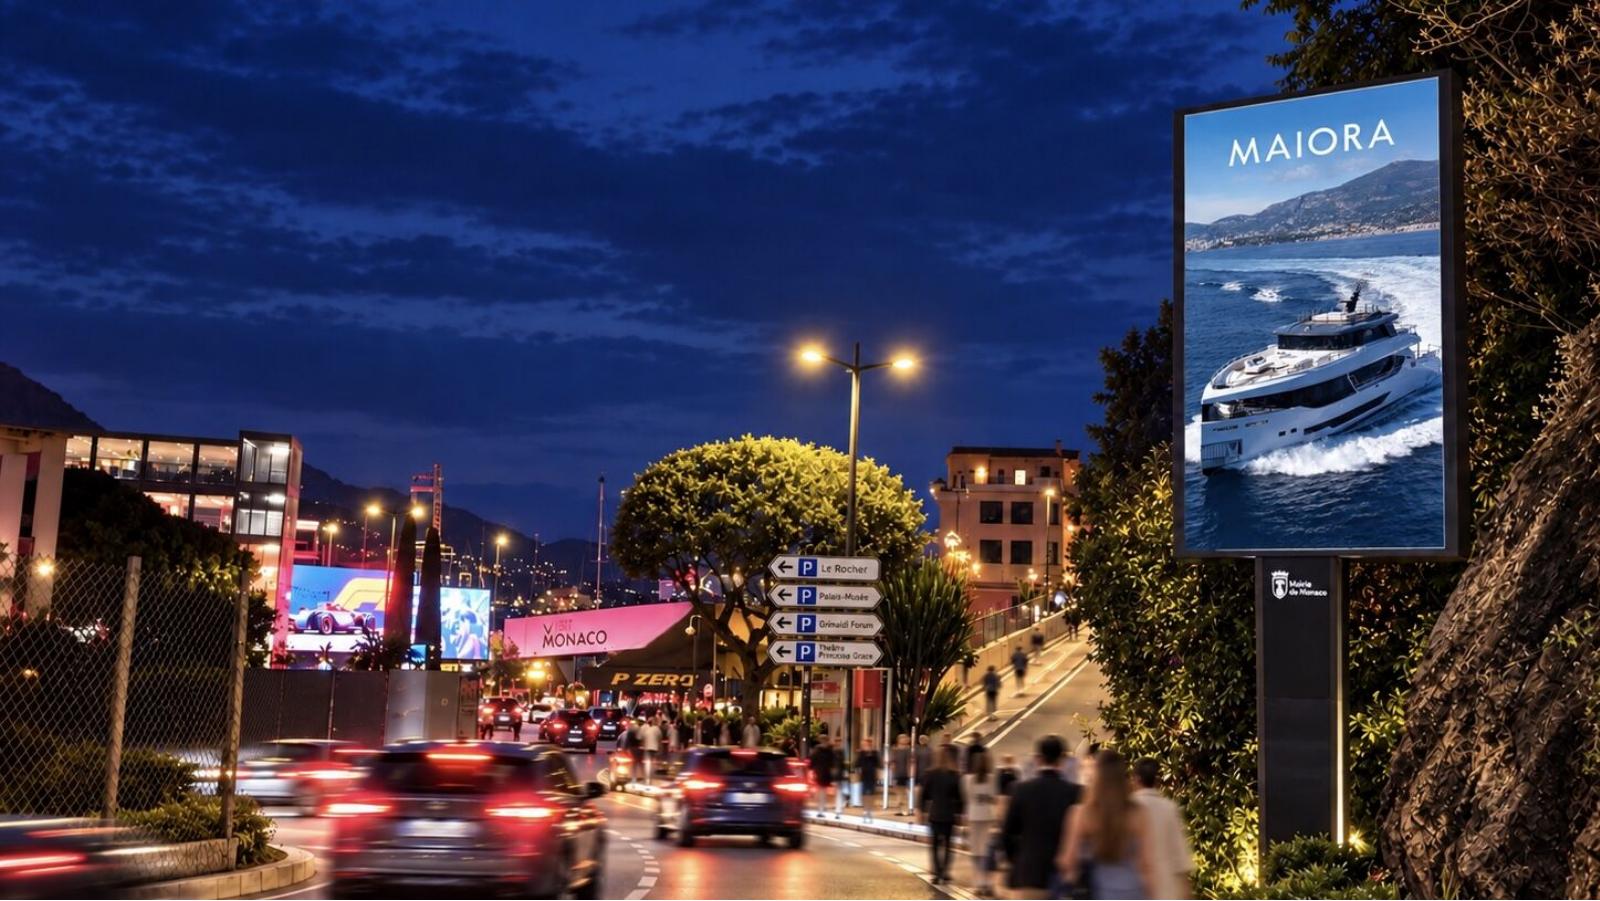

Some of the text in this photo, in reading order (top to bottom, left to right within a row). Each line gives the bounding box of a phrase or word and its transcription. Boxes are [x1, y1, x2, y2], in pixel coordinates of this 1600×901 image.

[1228, 118, 1395, 167] MAIORA
[803, 561, 868, 575] P Le Rocher
[802, 589, 812, 603] P
[1289, 588, 1328, 596] de Monaco
[801, 617, 874, 631] P Grimaldi Forum
[543, 630, 607, 648] MONACO
[801, 645, 811, 659] P
[853, 652, 873, 660] Grace
[610, 672, 694, 687] P ZERO
